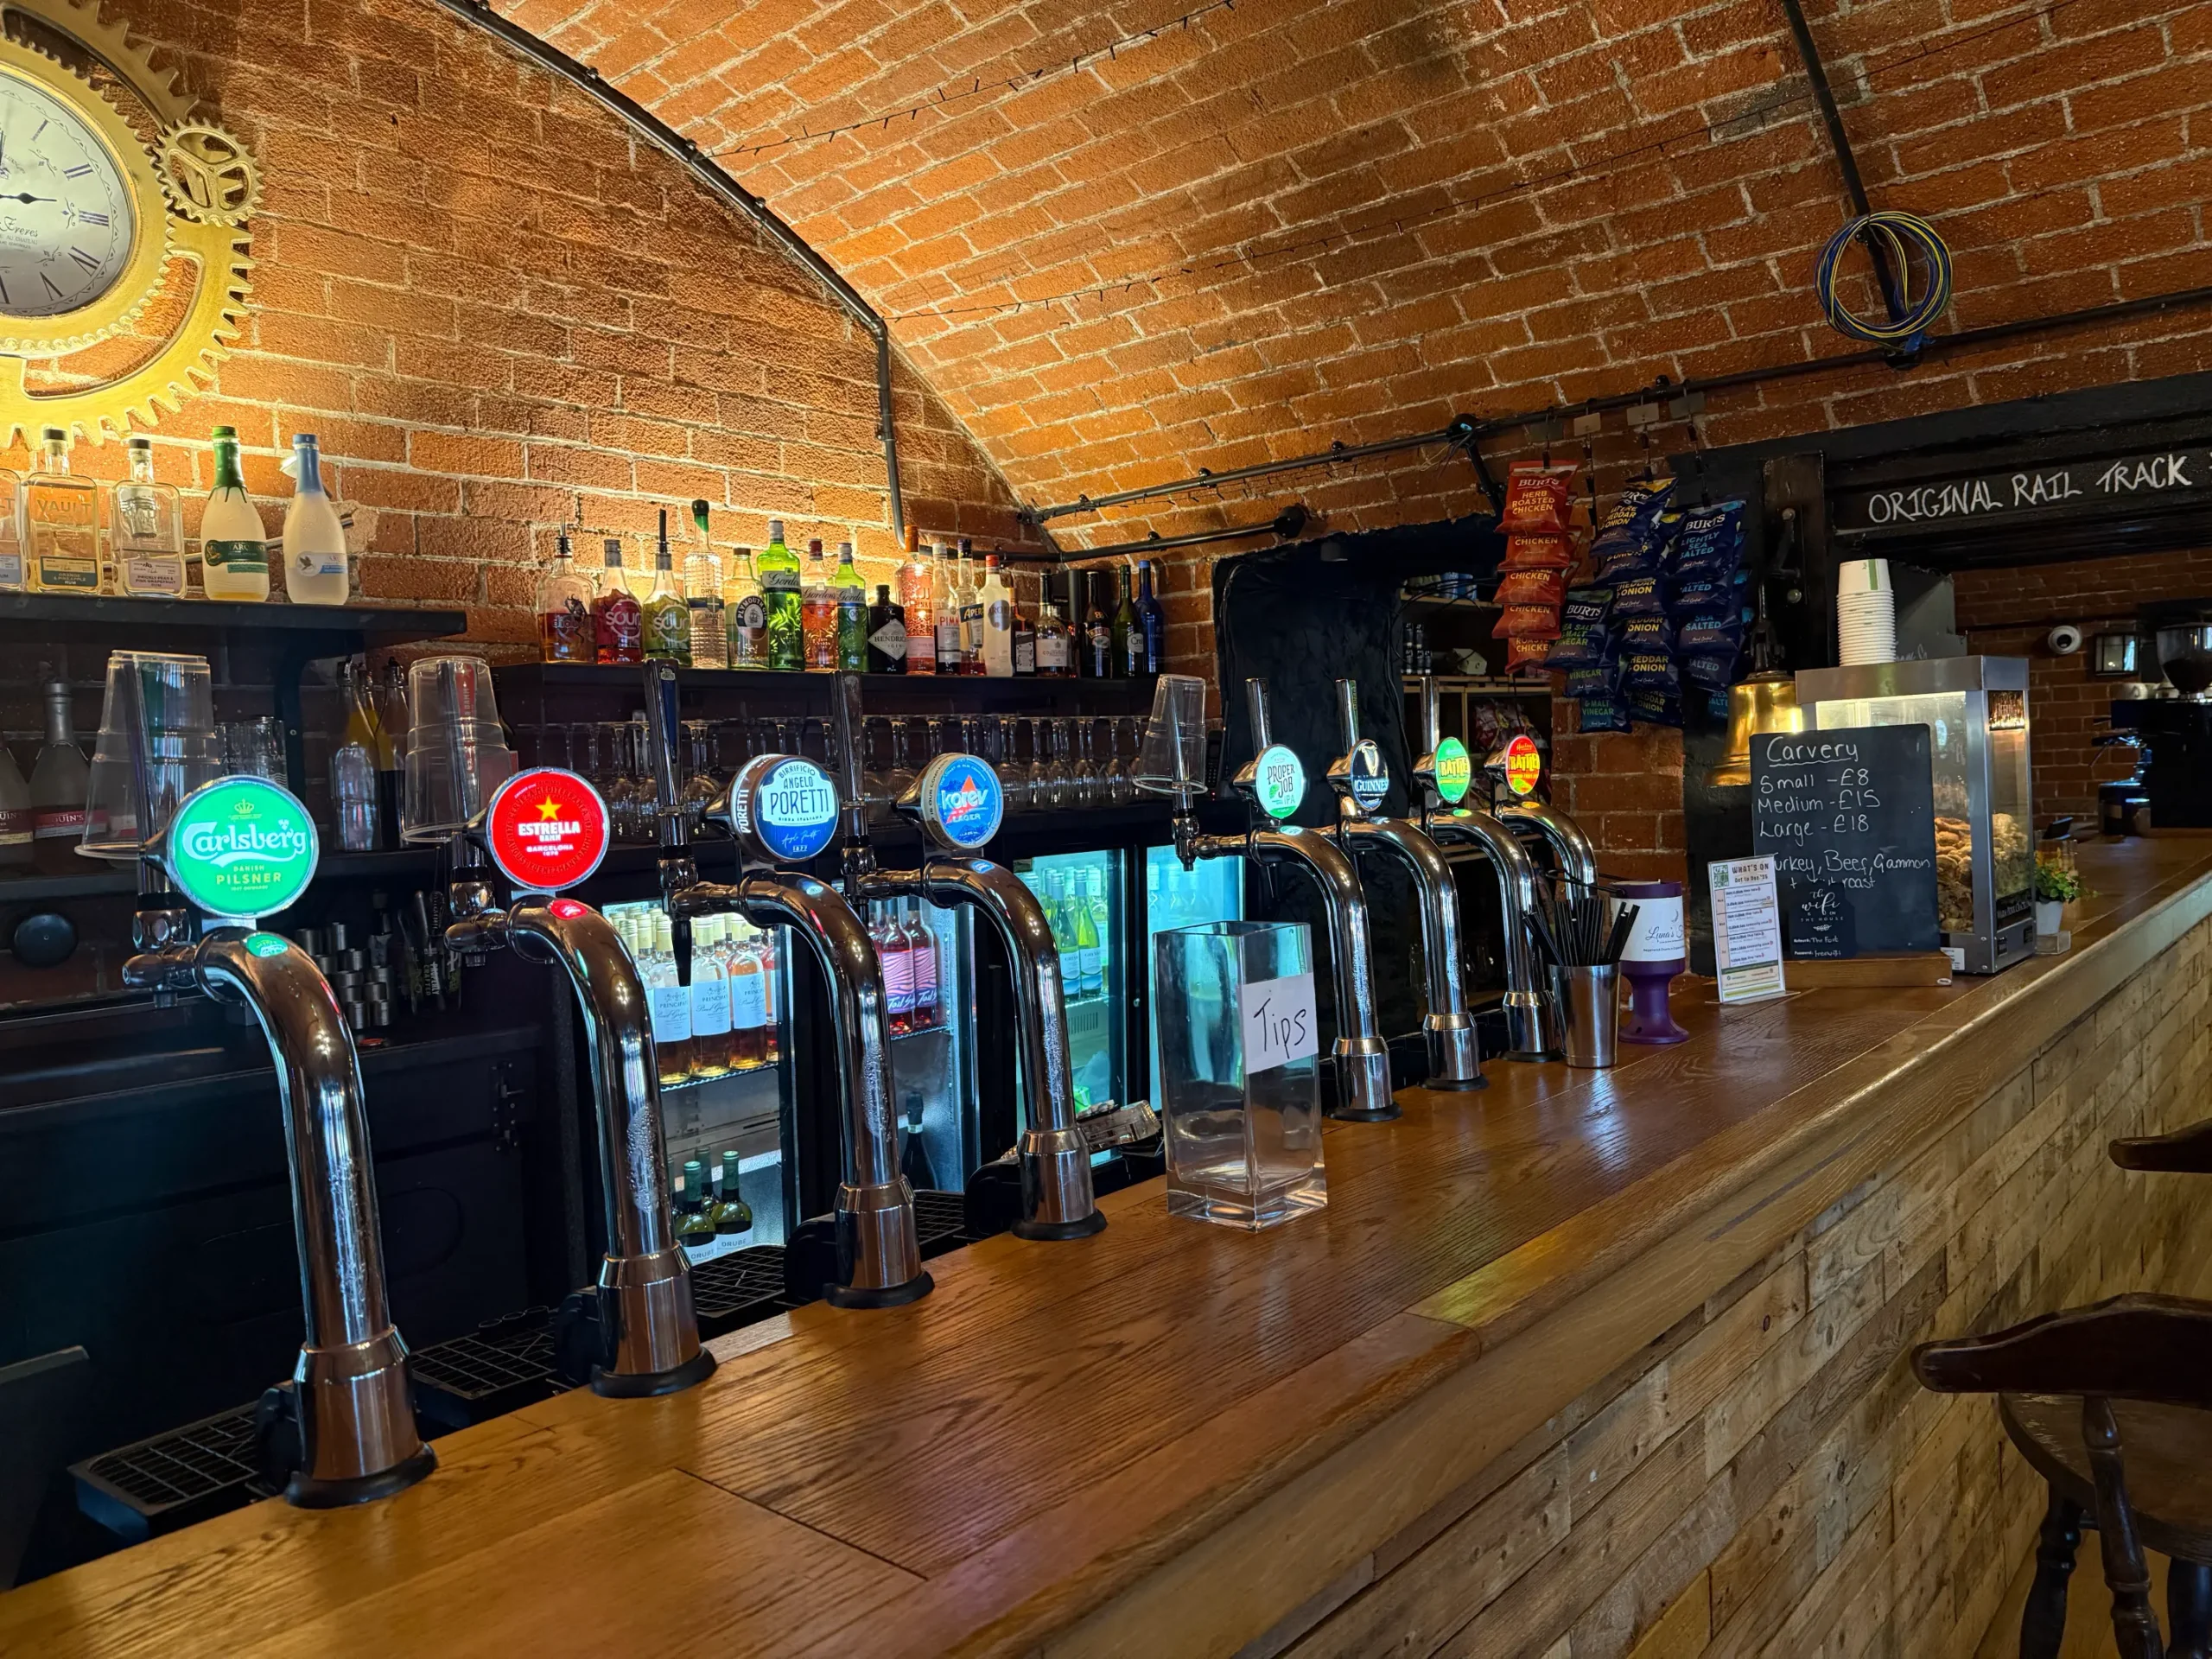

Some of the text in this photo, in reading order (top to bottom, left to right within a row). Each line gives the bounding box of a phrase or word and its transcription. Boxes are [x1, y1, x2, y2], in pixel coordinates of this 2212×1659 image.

[1517, 477, 1560, 487] BURTS
[1868, 453, 2193, 524] ORIGINAL RAIL TRACK
[1522, 490, 1548, 499] HERB
[1511, 497, 1555, 508] ROASTED
[1511, 504, 1554, 515] CHICKEN
[1683, 513, 1726, 532] BURTS
[1515, 537, 1558, 546] CHICKEN
[1688, 542, 1708, 550] SEA
[1510, 572, 1551, 582] CHICKEN
[1621, 586, 1653, 596] ONION
[1680, 584, 1712, 594] ALTED
[738, 597, 764, 619] PLYMOUTH
[1510, 605, 1551, 614] CHICKEN
[1566, 604, 1603, 618] BURTS
[1685, 621, 1722, 632] SALTED
[1516, 644, 1549, 652] CHICKE
[1569, 668, 1603, 680] VINEGAR
[1633, 664, 1666, 672] ONION
[1591, 699, 1611, 708] MALT
[1582, 707, 1615, 715] VINEGAR
[1766, 735, 1859, 764] Carvery
[779, 764, 816, 779] BIRRIFICIO
[1267, 763, 1296, 785] PROPER
[783, 776, 813, 790] ANGELO
[1278, 776, 1294, 798] JOB
[1355, 779, 1389, 792] GUINNES
[1759, 774, 1815, 794] Small
[770, 788, 829, 816] PORETTI
[941, 789, 988, 810] korev
[1757, 797, 1824, 814] Medium
[736, 789, 752, 834] PORETTI
[952, 813, 981, 823] LAGER
[518, 821, 581, 836] ESTRELLA
[1759, 821, 1815, 846] Large
[182, 819, 307, 862] Carlsberg
[526, 843, 574, 853] BARCELONA
[1732, 864, 1758, 874] WHAT'S
[1773, 852, 1822, 883] urkey,
[1873, 854, 1930, 873] Gammon
[216, 872, 282, 885] PILSNER
[1842, 876, 1876, 889] roast
[1802, 892, 1840, 915] wifi
[1254, 997, 1306, 1059] Tips
